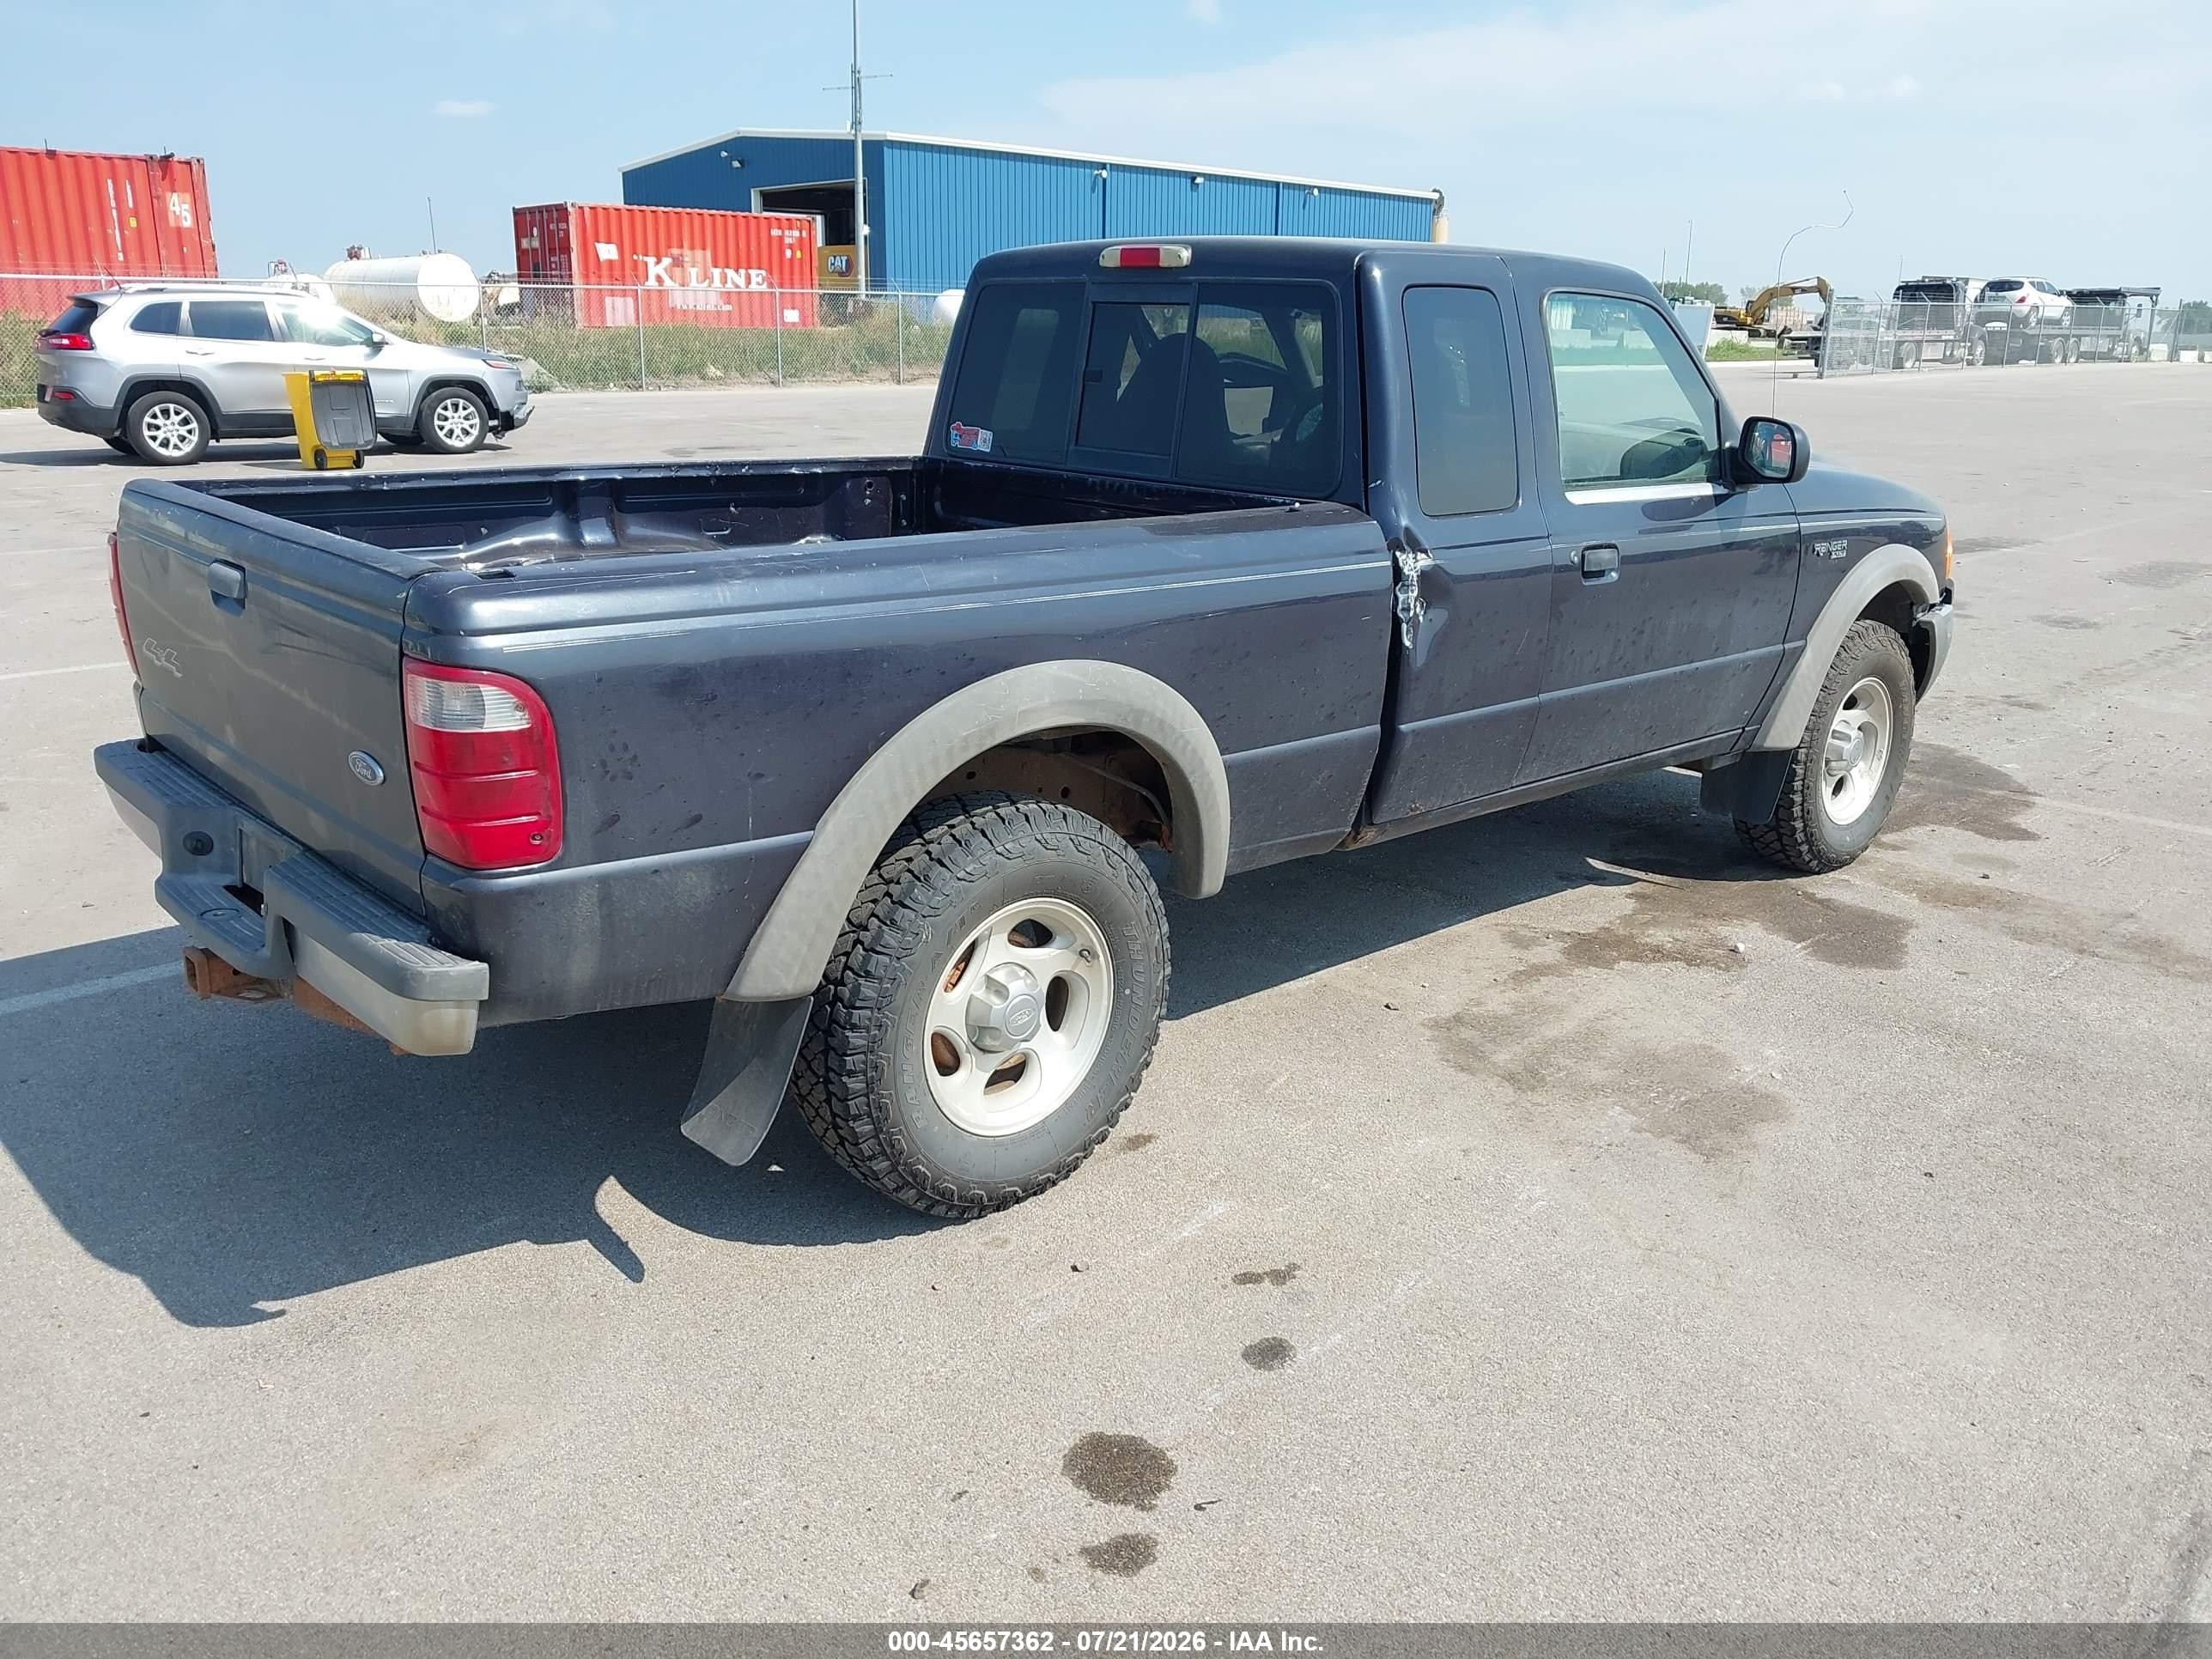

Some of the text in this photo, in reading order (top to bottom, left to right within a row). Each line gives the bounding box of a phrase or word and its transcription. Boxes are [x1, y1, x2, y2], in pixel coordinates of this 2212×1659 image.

[169, 191, 192, 228] 45
[828, 255, 848, 273] CAT
[688, 267, 768, 289] LINE
[1814, 539, 1848, 556] RANGER
